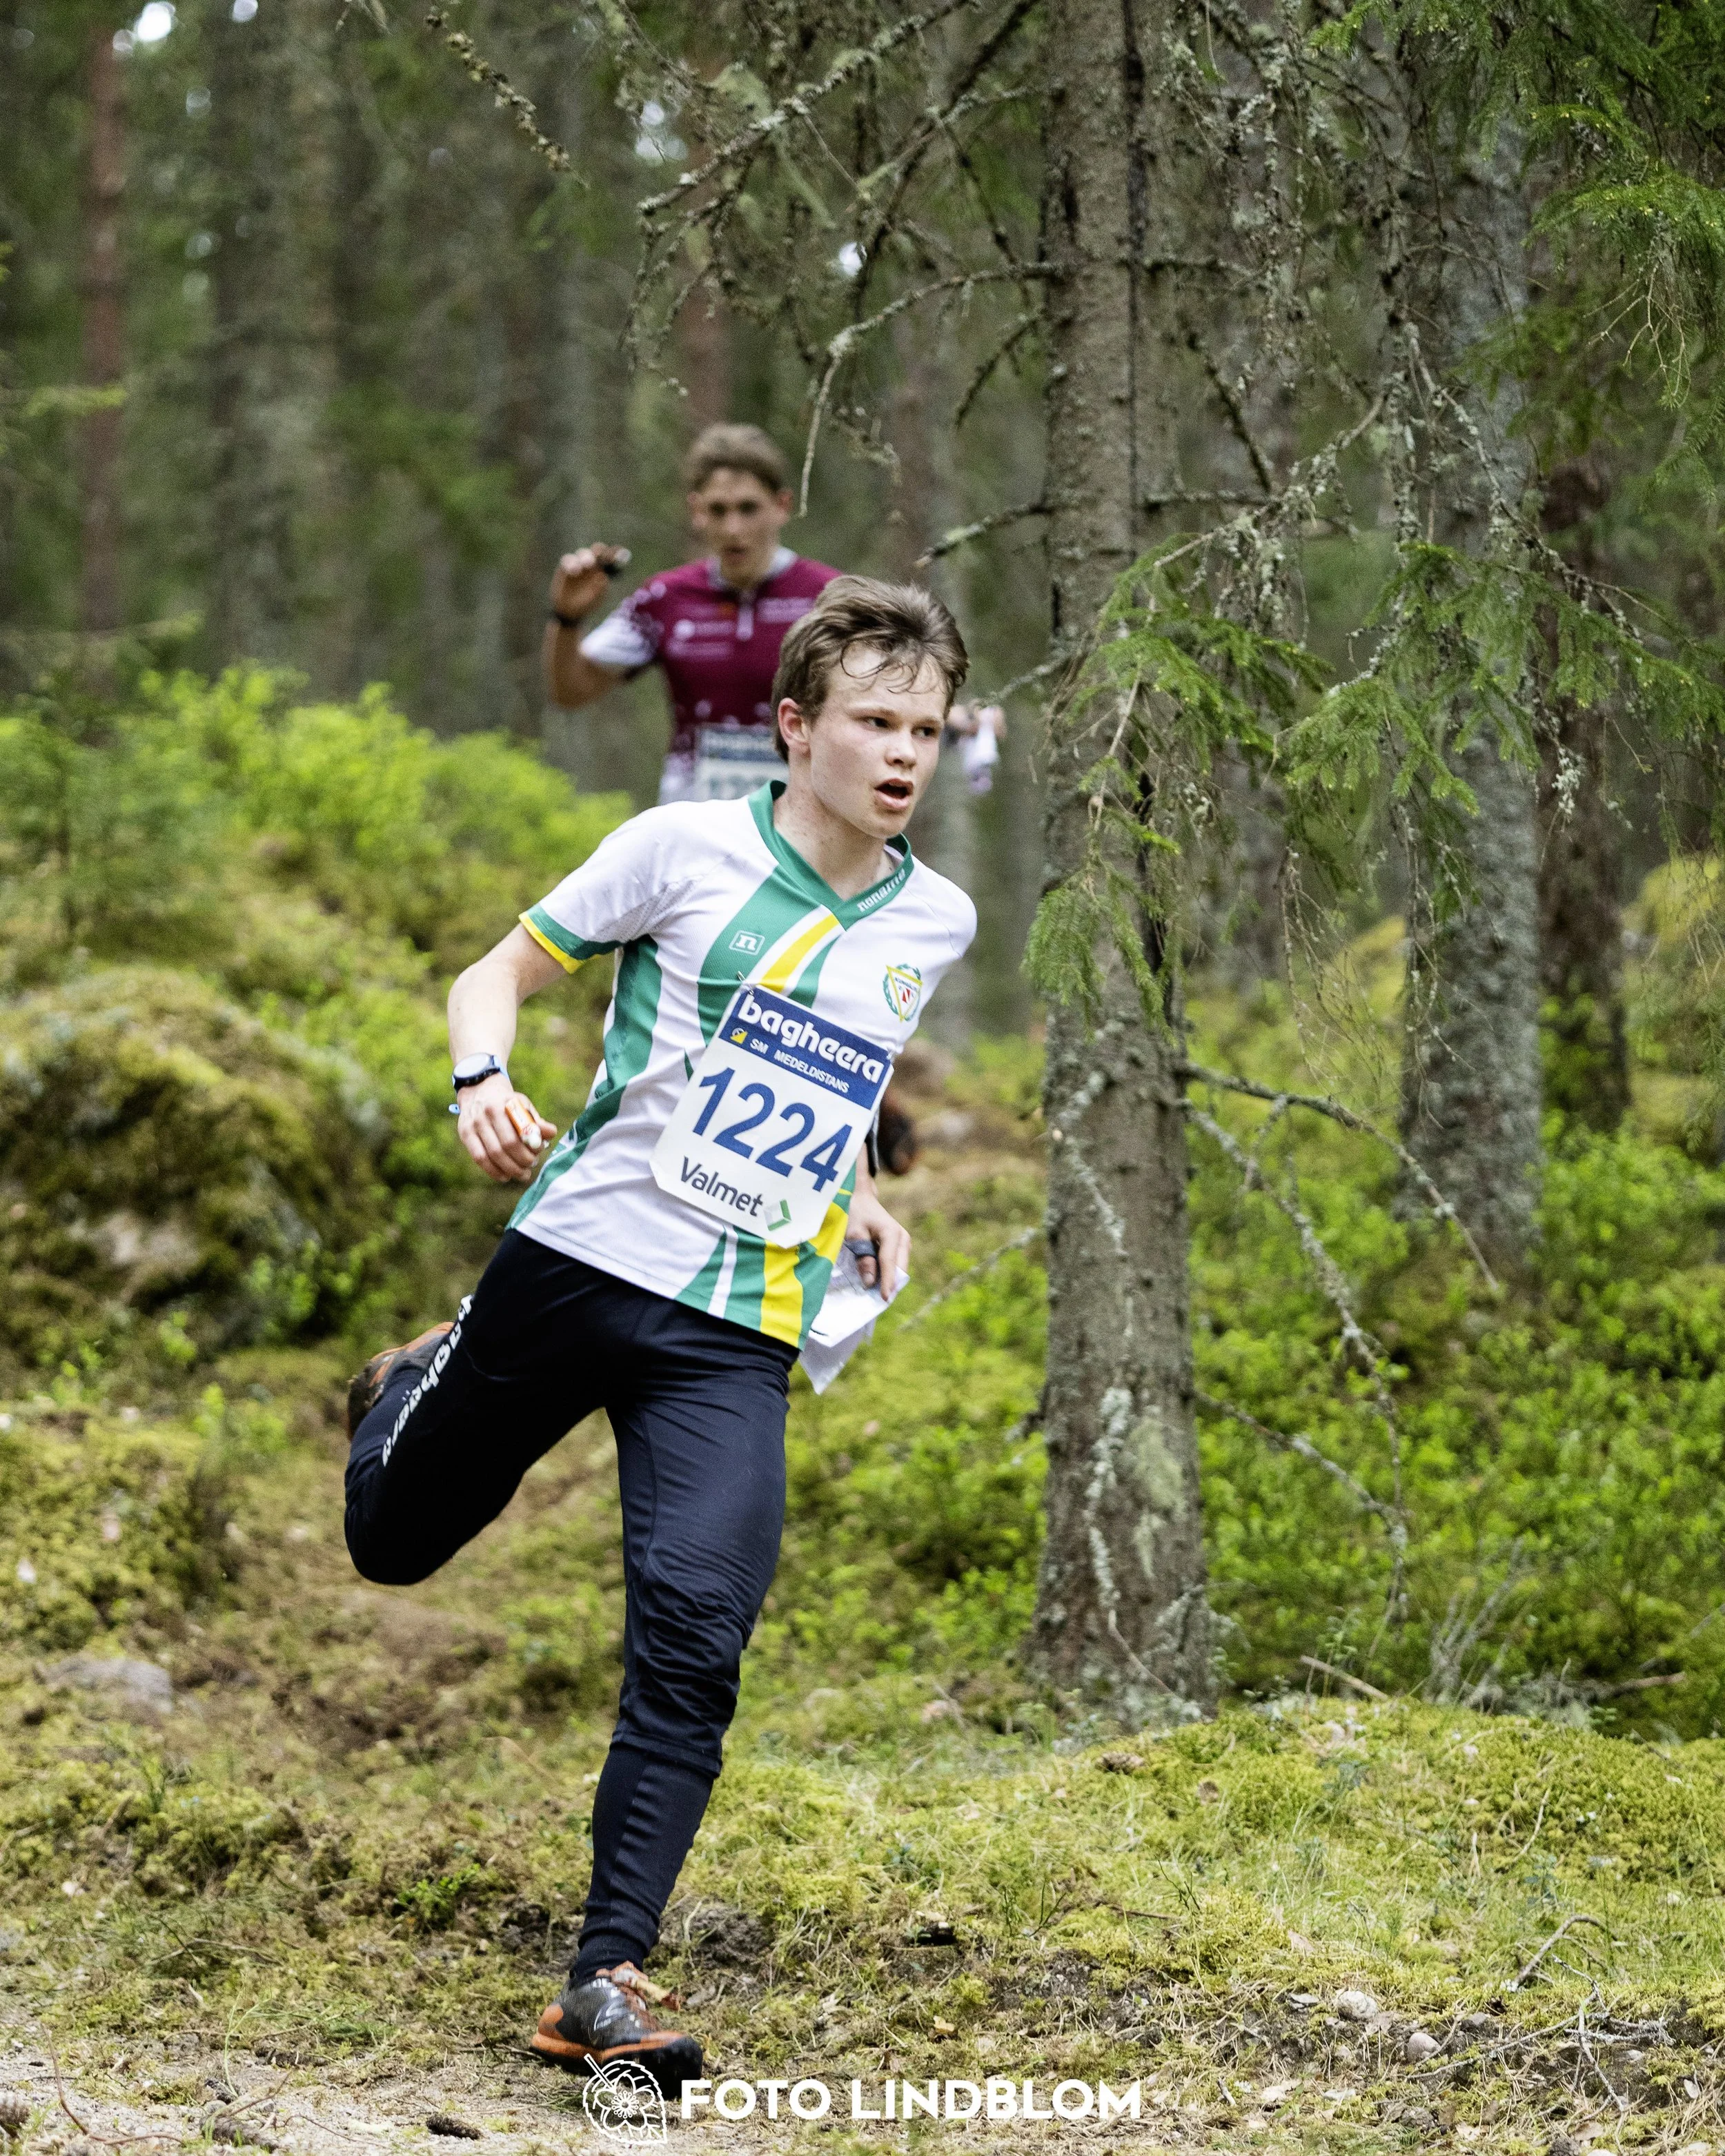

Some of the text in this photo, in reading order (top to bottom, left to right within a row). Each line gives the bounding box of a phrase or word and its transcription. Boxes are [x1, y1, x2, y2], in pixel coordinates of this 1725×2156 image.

[738, 995, 885, 1083] bagheera
[749, 1038, 850, 1094] SM MEDELDISTANS
[693, 1067, 853, 1192] 1224
[680, 1156, 763, 1217] Valmet
